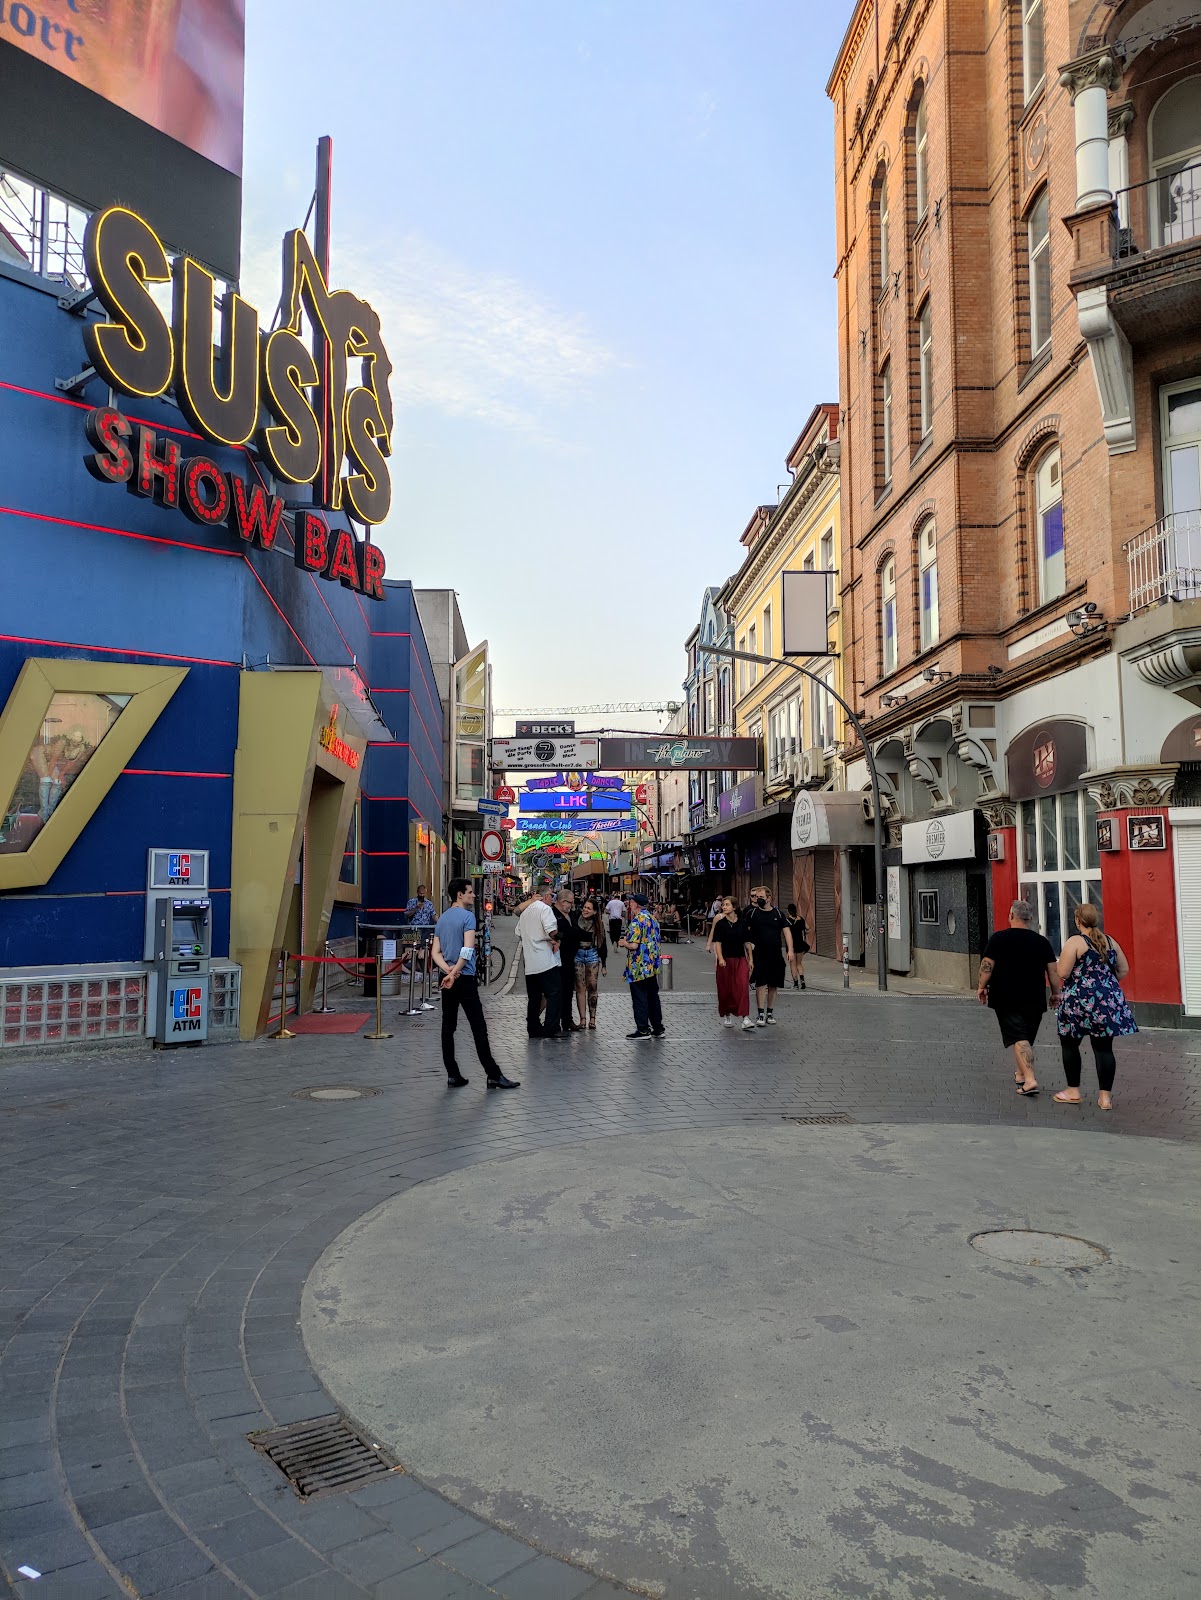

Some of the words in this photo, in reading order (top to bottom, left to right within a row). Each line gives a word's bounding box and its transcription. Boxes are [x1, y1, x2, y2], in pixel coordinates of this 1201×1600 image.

[83, 406, 284, 552] SHOW
[295, 509, 386, 601] BAR
[535, 776, 559, 788] TABLE
[591, 777, 615, 788] DANCE
[519, 819, 547, 830] Beach
[550, 820, 572, 830] Club
[514, 831, 566, 854] Safari
[926, 832, 946, 846] PREMIER
[172, 1019, 202, 1032] ATM
